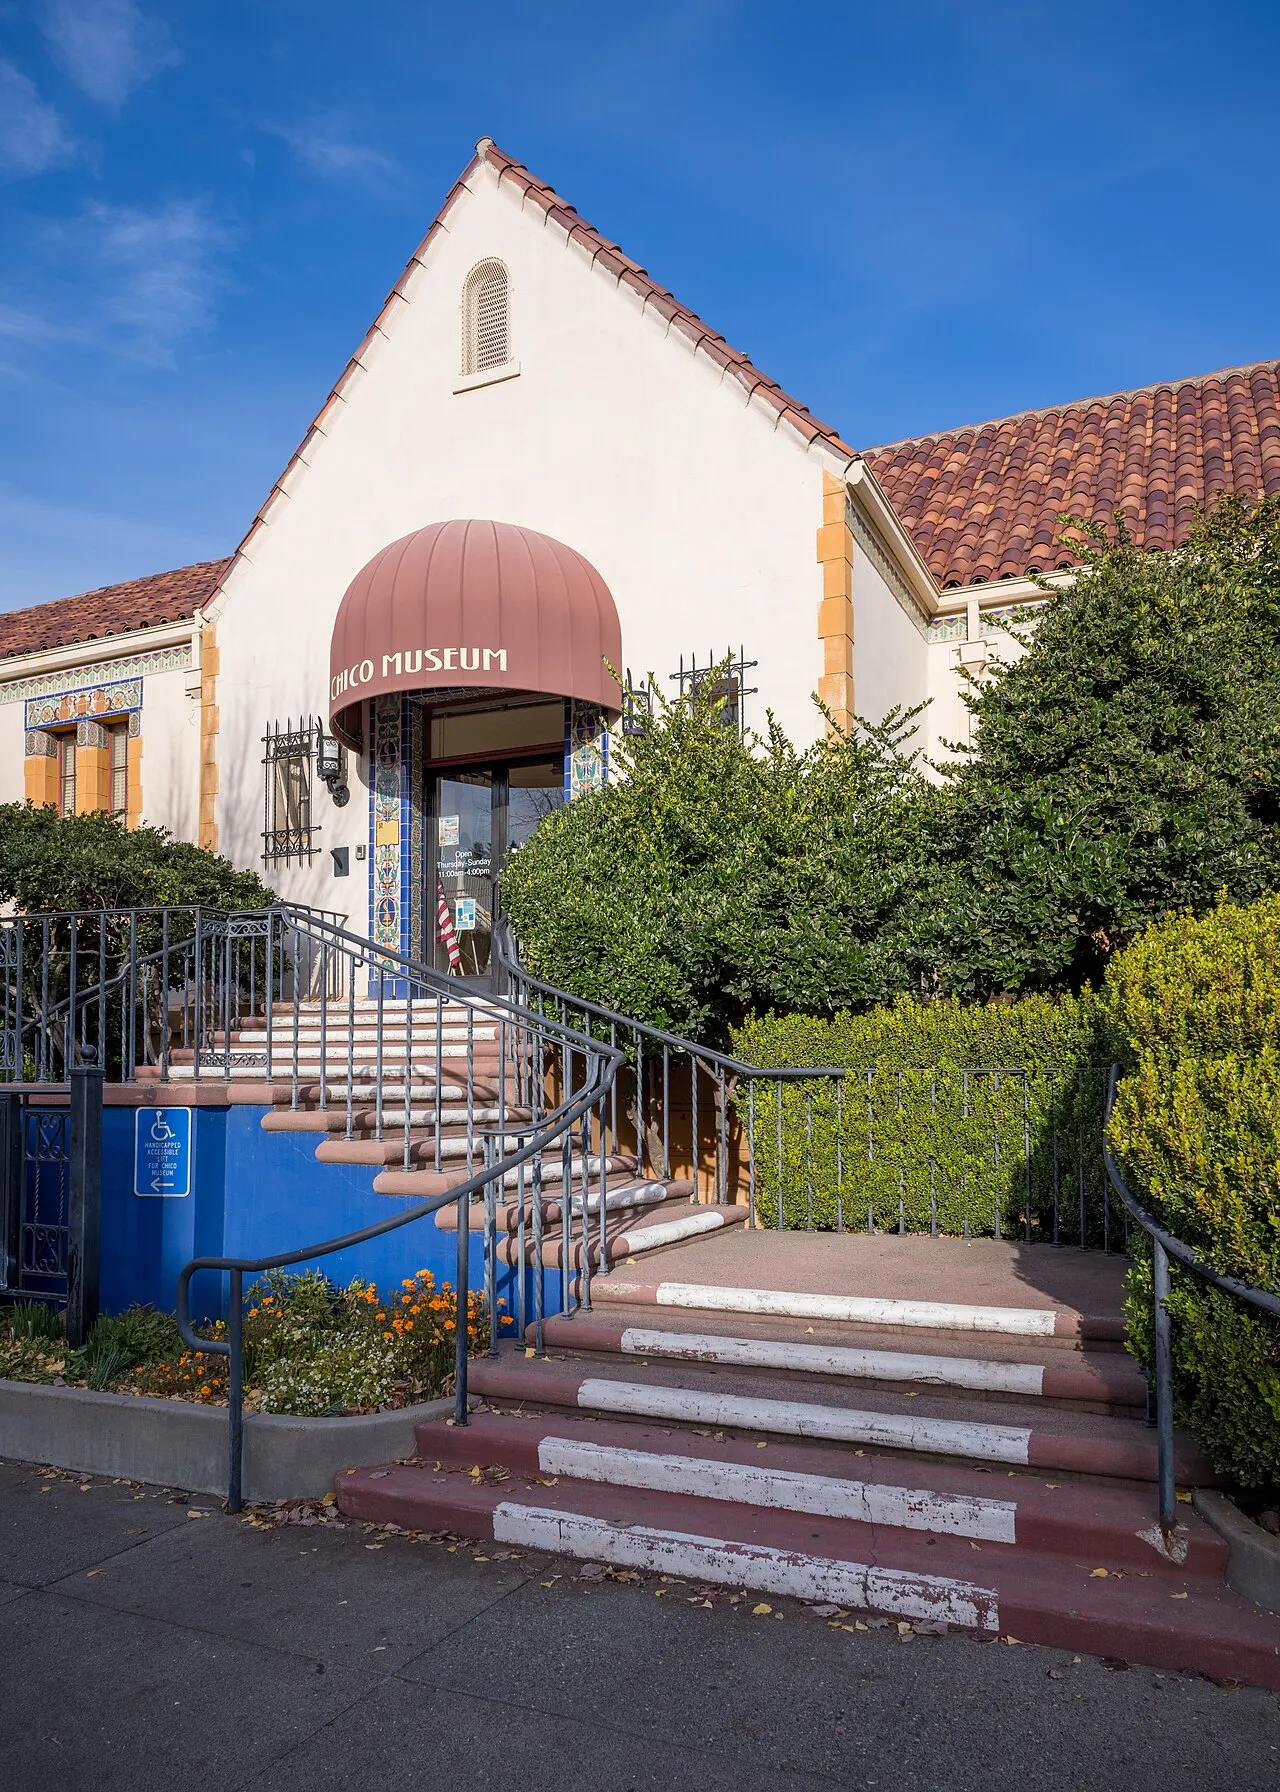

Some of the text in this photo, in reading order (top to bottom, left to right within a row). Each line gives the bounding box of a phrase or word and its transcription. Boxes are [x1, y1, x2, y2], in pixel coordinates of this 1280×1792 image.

[331, 647, 508, 701] CHICO MUSEUM
[454, 850, 472, 858] Open
